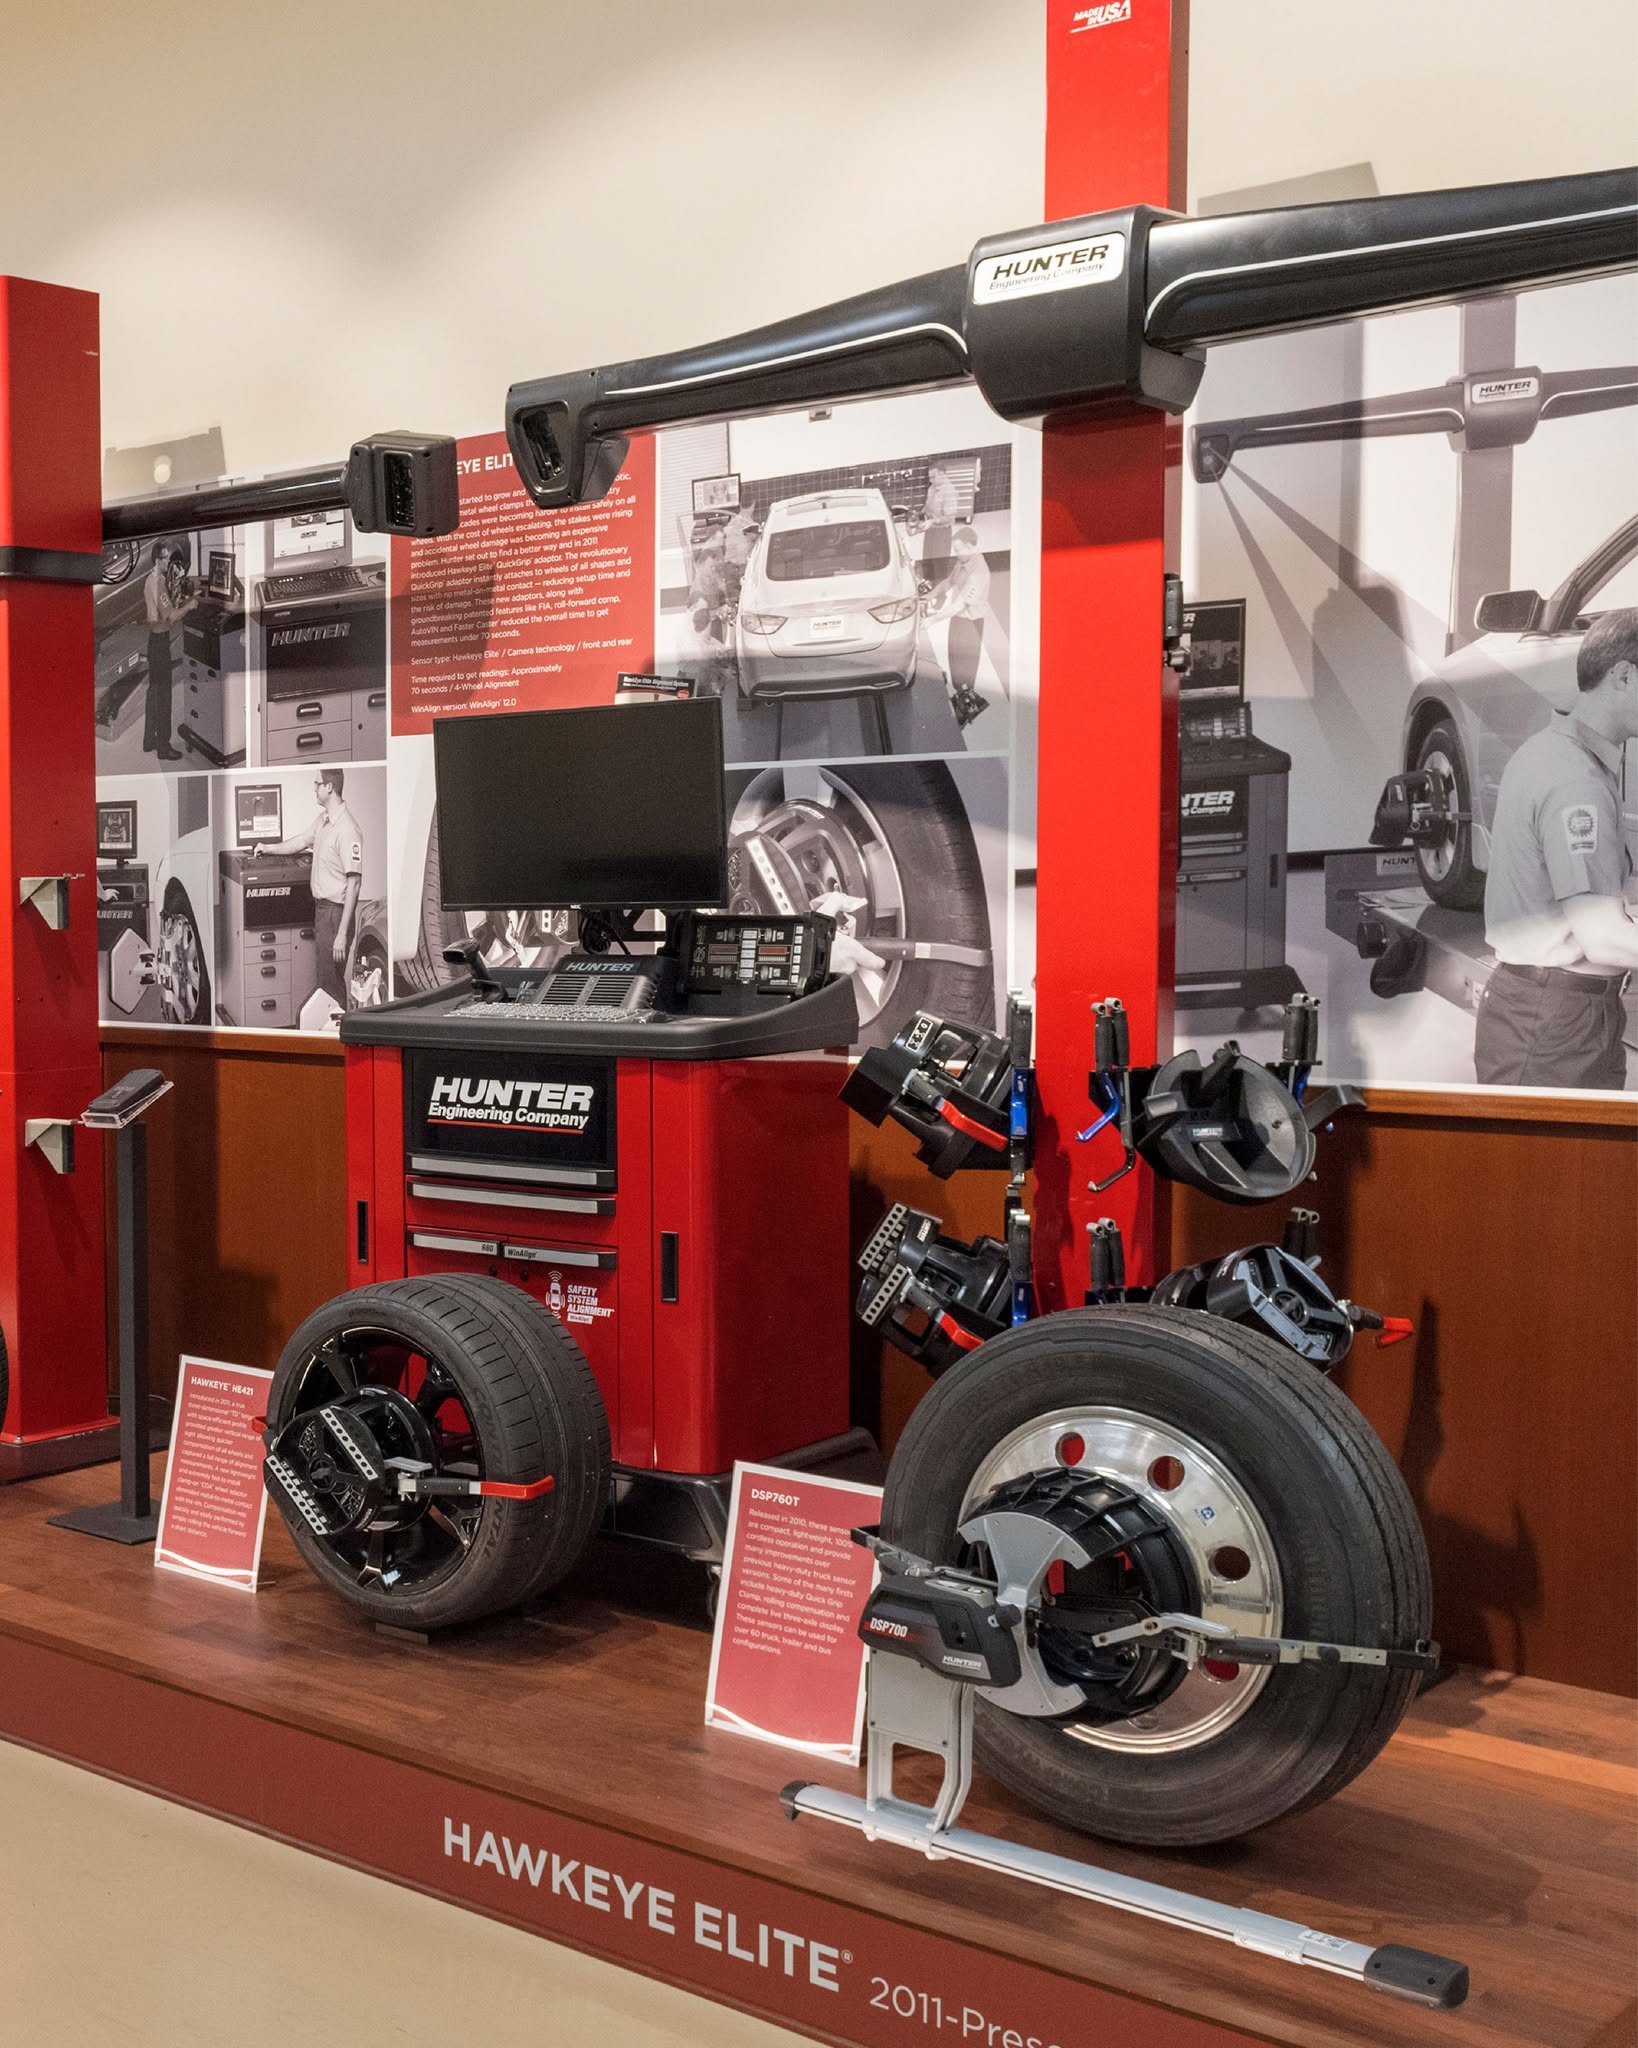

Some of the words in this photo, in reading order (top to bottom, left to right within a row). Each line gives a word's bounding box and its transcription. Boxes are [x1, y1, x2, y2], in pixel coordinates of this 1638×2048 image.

[1073, 6, 1102, 21] MADE
[1097, 0, 1131, 23] USA
[993, 244, 1109, 280] HUNTER
[989, 273, 1051, 290] Engineering
[1053, 263, 1104, 279] Company
[1480, 380, 1531, 393] HUNTER
[485, 453, 514, 471] ELIT
[436, 532, 452, 541] With
[453, 531, 464, 539] the
[465, 529, 480, 537] cost
[481, 527, 489, 535] of
[490, 524, 514, 534] wheels
[554, 517, 566, 525] the
[567, 514, 590, 523] stakes
[611, 509, 632, 518] rising
[410, 547, 423, 556] and
[424, 542, 457, 554] accidental
[459, 540, 479, 550] wheel
[480, 538, 508, 547] damage
[524, 531, 559, 541] becoming
[571, 524, 608, 536] expensive
[440, 555, 463, 563] Hunter
[464, 552, 474, 560] set
[476, 550, 488, 559] out
[498, 547, 512, 556] find
[519, 544, 541, 553] better
[542, 543, 556, 551] way
[558, 539, 572, 548] and
[582, 536, 598, 545] 2011
[564, 551, 578, 559] The
[579, 546, 627, 557] revolutionary
[504, 568, 533, 578] attaches
[544, 564, 569, 574] wheels
[570, 562, 578, 570] of
[580, 561, 588, 569] all
[590, 560, 615, 569] shapes
[617, 556, 631, 565] and
[506, 580, 532, 590] contact
[542, 576, 574, 586] reducing
[575, 574, 595, 582] setup
[615, 568, 630, 577] and
[545, 589, 565, 598] along
[567, 585, 583, 594] with
[495, 606, 523, 614] features
[525, 603, 536, 611] like
[554, 596, 596, 608] roll-forward
[500, 615, 529, 625] reduced
[530, 614, 542, 622] the
[543, 611, 567, 620] overall
[568, 610, 585, 618] time
[596, 607, 608, 617] get
[272, 623, 350, 647] HUNTER
[480, 630, 489, 639] 70
[411, 656, 432, 664] Sensor
[507, 647, 533, 655] Camera
[535, 643, 575, 652] technology
[582, 640, 600, 648] front
[601, 638, 616, 646] and
[411, 675, 427, 683] Time
[428, 672, 455, 683] required
[465, 670, 477, 680] get
[511, 663, 561, 676] Approximately
[411, 685, 420, 694] 70
[421, 684, 447, 693] seconds
[454, 680, 482, 690] 4-Wheel
[483, 678, 519, 689] Alignment
[502, 696, 516, 705] 12.0
[1181, 790, 1235, 807] NTER
[1190, 805, 1232, 815] Company
[1383, 857, 1416, 865] HUNT
[246, 886, 291, 898] HUNTER
[97, 910, 133, 919] UNTER
[566, 962, 634, 972] HUNTER
[430, 1076, 594, 1112] HUNTER
[428, 1102, 513, 1124] Engineering
[515, 1107, 589, 1129] Company
[567, 1284, 598, 1296] SAFETY
[567, 1294, 598, 1306] SYSTEM
[232, 1384, 254, 1396] HE421
[751, 1488, 800, 1507] DSP760T
[870, 1617, 908, 1637] DSP700
[443, 1816, 675, 1934] HAWKEYE
